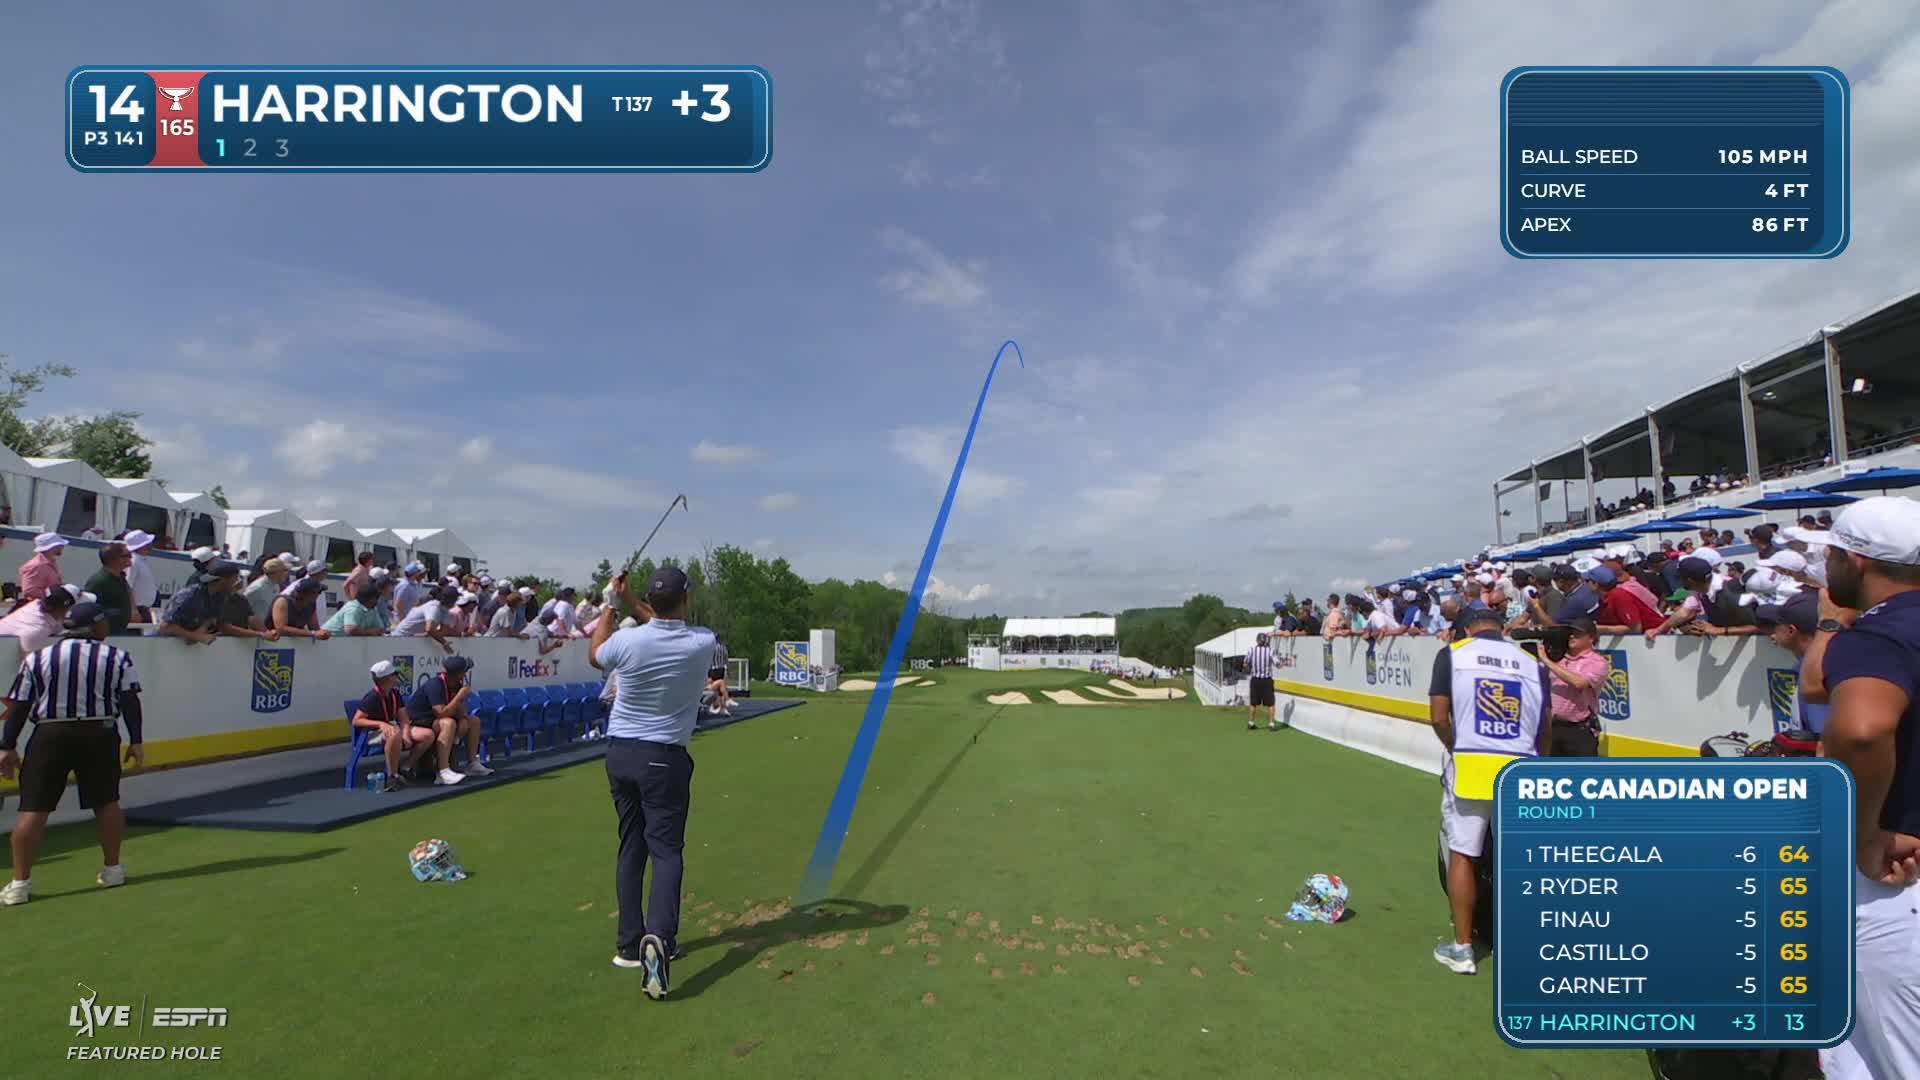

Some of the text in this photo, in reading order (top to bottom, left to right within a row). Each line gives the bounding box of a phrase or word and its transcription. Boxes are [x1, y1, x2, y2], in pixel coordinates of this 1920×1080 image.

[519, 659, 549, 678] FedEx
[910, 659, 934, 670] RBC
[779, 671, 807, 683] RBC
[1378, 666, 1411, 687] OPEN
[255, 694, 290, 708] RBC
[1599, 698, 1629, 717] RBC
[1479, 720, 1519, 737] RBC
